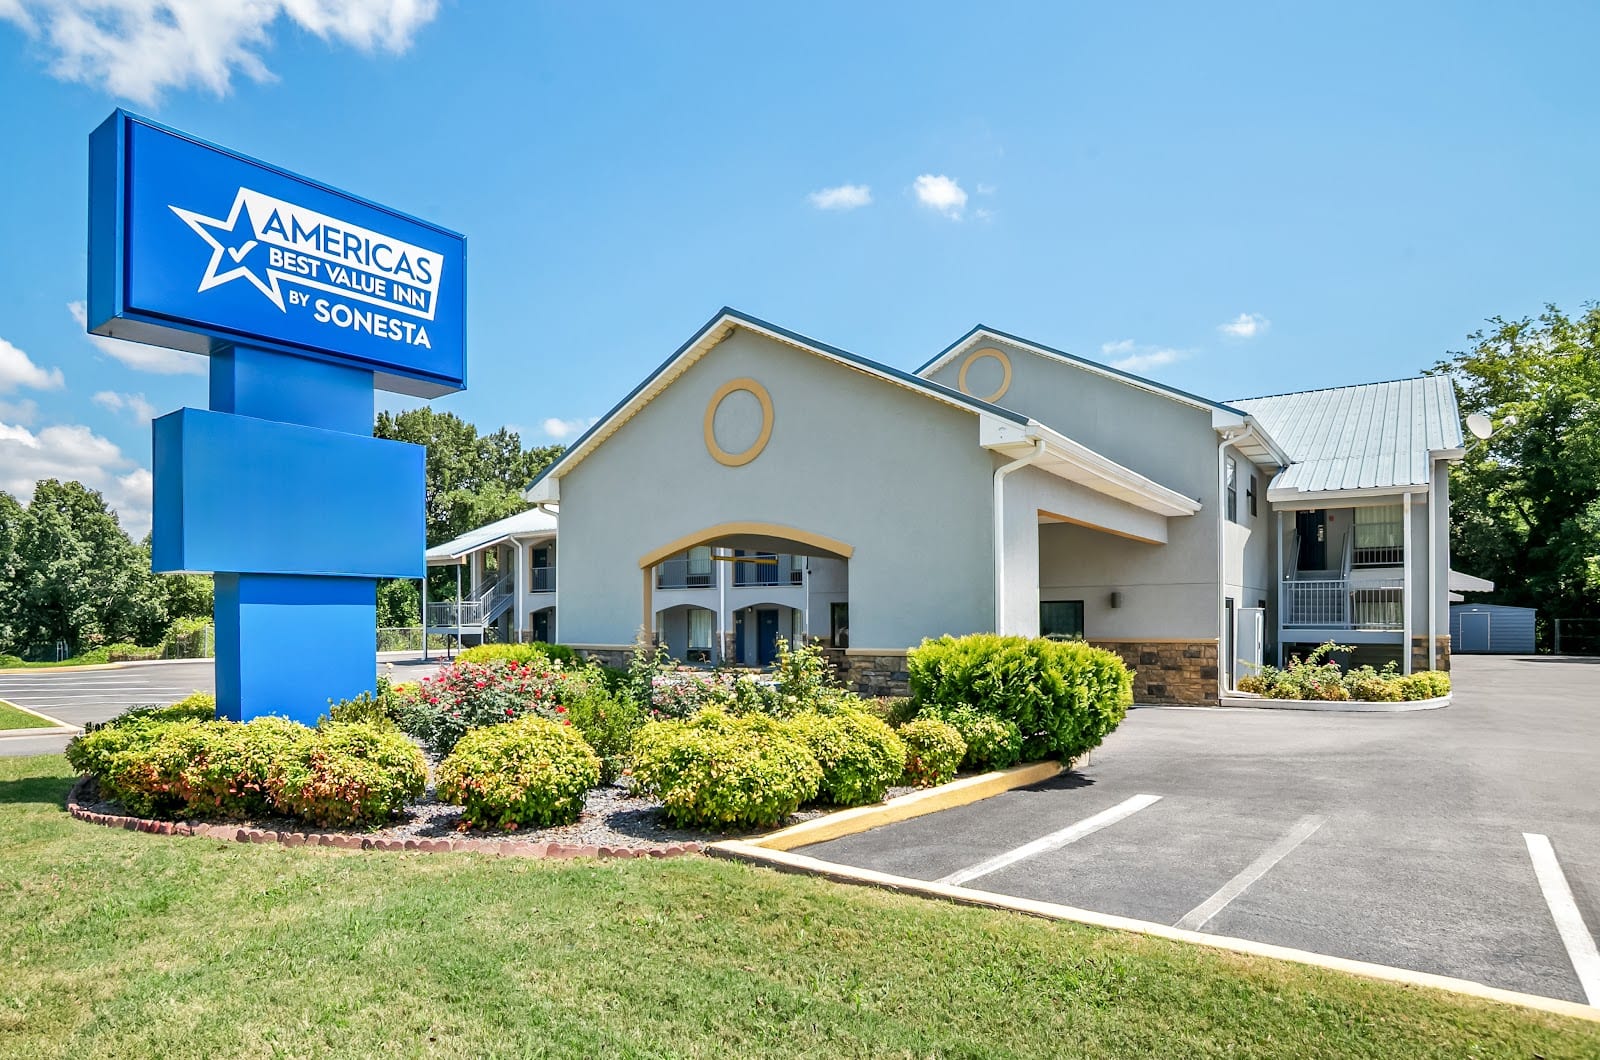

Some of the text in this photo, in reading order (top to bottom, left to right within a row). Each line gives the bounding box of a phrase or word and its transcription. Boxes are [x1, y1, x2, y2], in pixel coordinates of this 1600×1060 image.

[261, 208, 432, 285] AMERICAS
[269, 247, 425, 309] BEST VALUE INN
[289, 290, 431, 349] BY SONESTA
